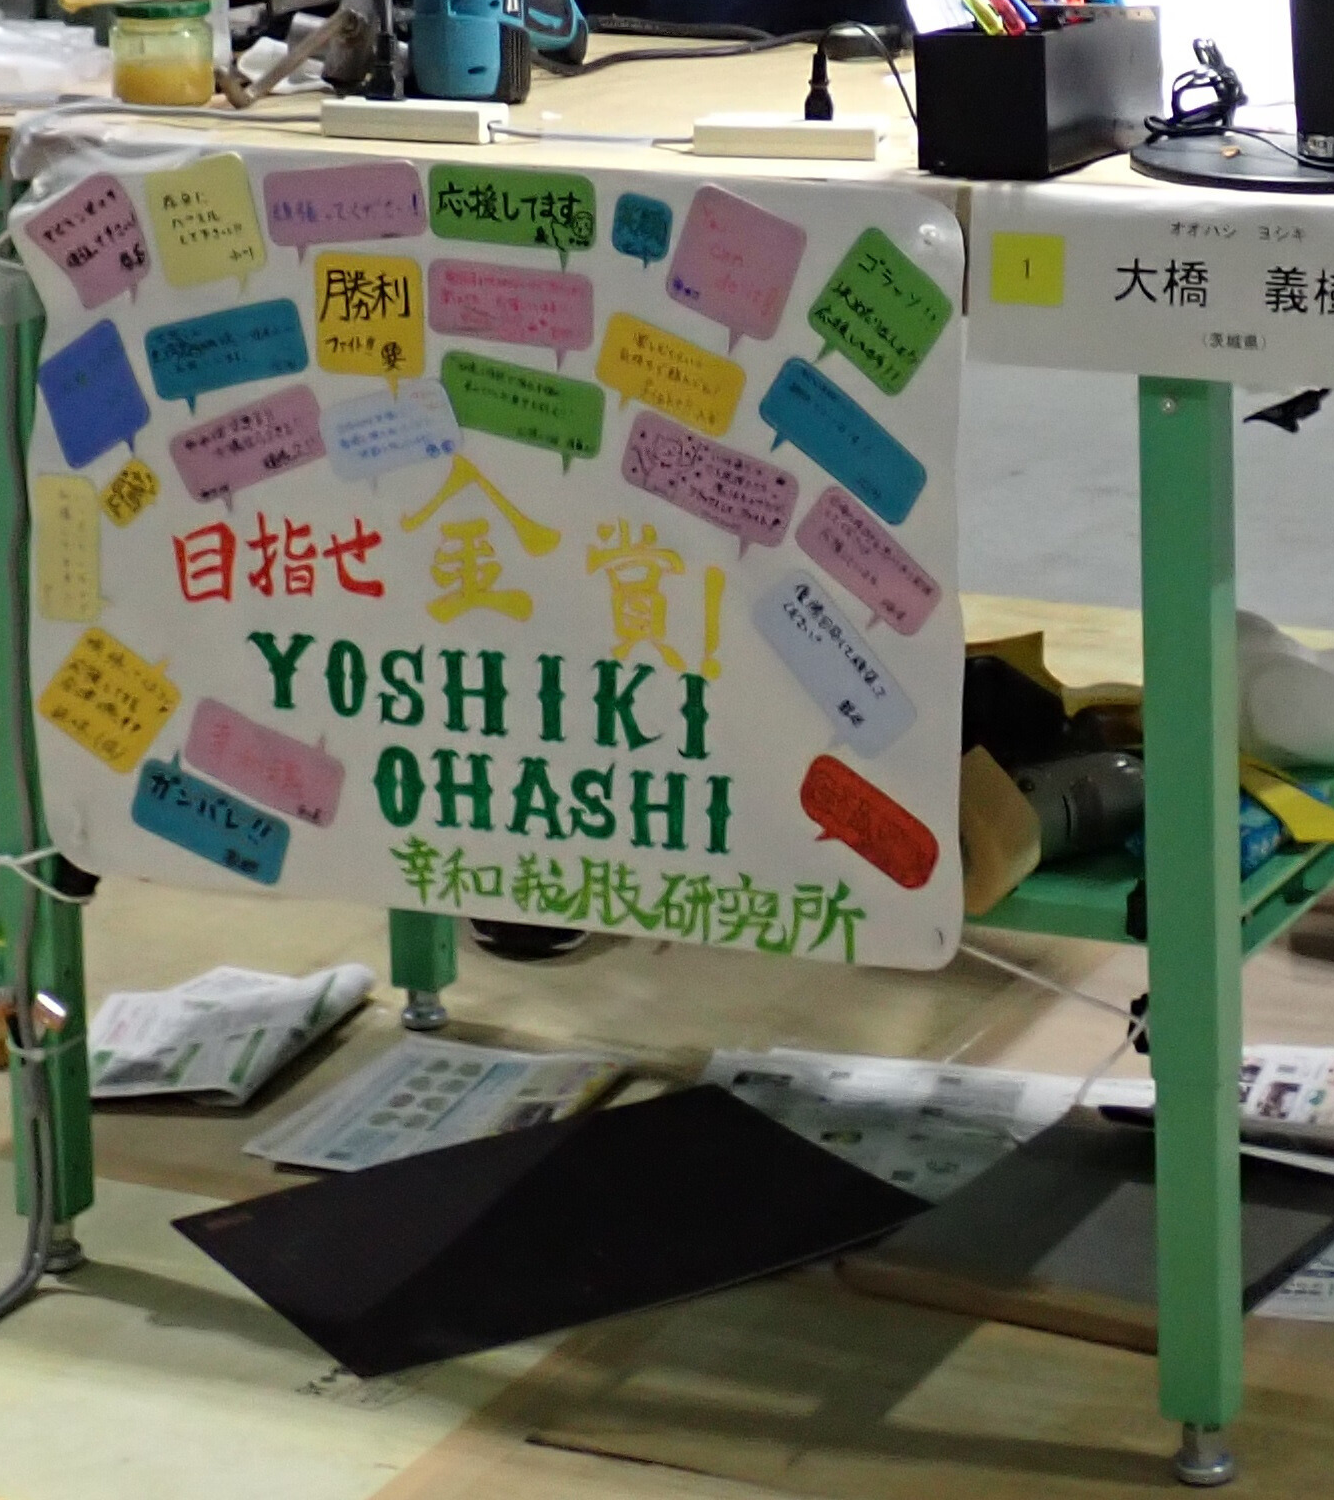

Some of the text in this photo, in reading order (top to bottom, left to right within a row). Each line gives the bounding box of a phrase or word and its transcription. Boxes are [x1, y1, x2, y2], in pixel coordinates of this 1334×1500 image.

[1169, 220, 1306, 243] オオハシ ヨシキ
[320, 268, 411, 322] 勝利
[1021, 258, 1032, 280] 1
[1114, 257, 1209, 308] 大橋
[247, 630, 710, 761] YOSHIKI
[373, 744, 732, 855] OHASHI
